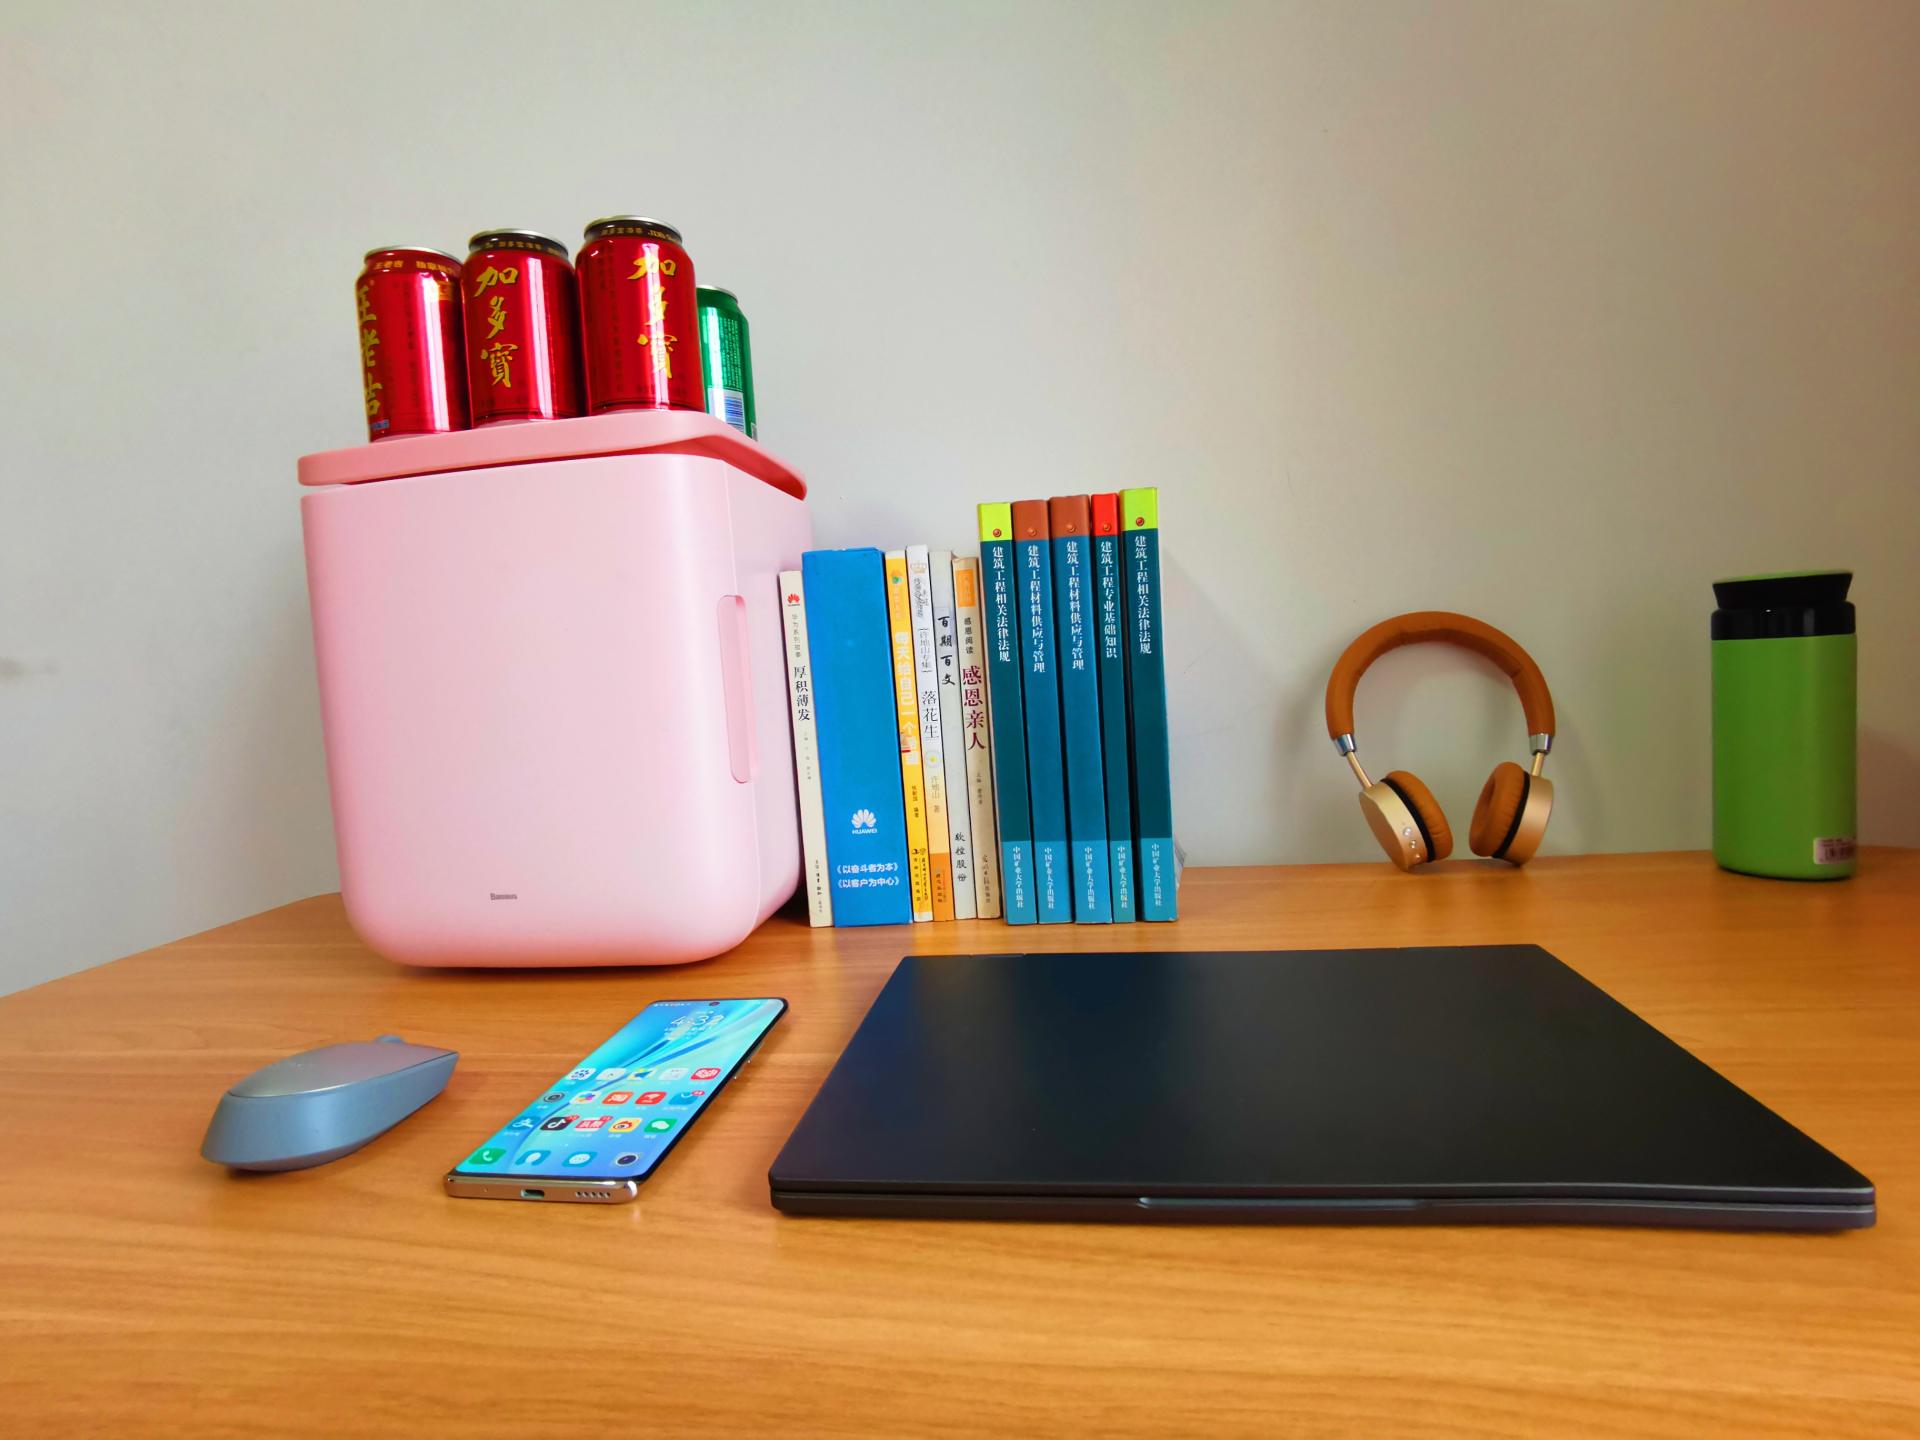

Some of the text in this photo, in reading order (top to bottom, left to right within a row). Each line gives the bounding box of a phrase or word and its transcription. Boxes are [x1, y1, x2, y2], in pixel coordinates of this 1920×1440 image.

[937, 615, 956, 686] 百期百文
[992, 546, 1011, 662] 建筑工程相关法律法规
[1027, 544, 1046, 673] 建筑工程材料供应与管理
[1066, 541, 1085, 671] 建筑工程材料供应与管理
[1100, 541, 1118, 659] 建筑工程专业基础知识
[1134, 535, 1152, 655] 建筑工程相关法律法规
[793, 665, 811, 721] 厚积薄发
[922, 690, 940, 738] 落花生
[962, 665, 986, 750] 感恩亲人
